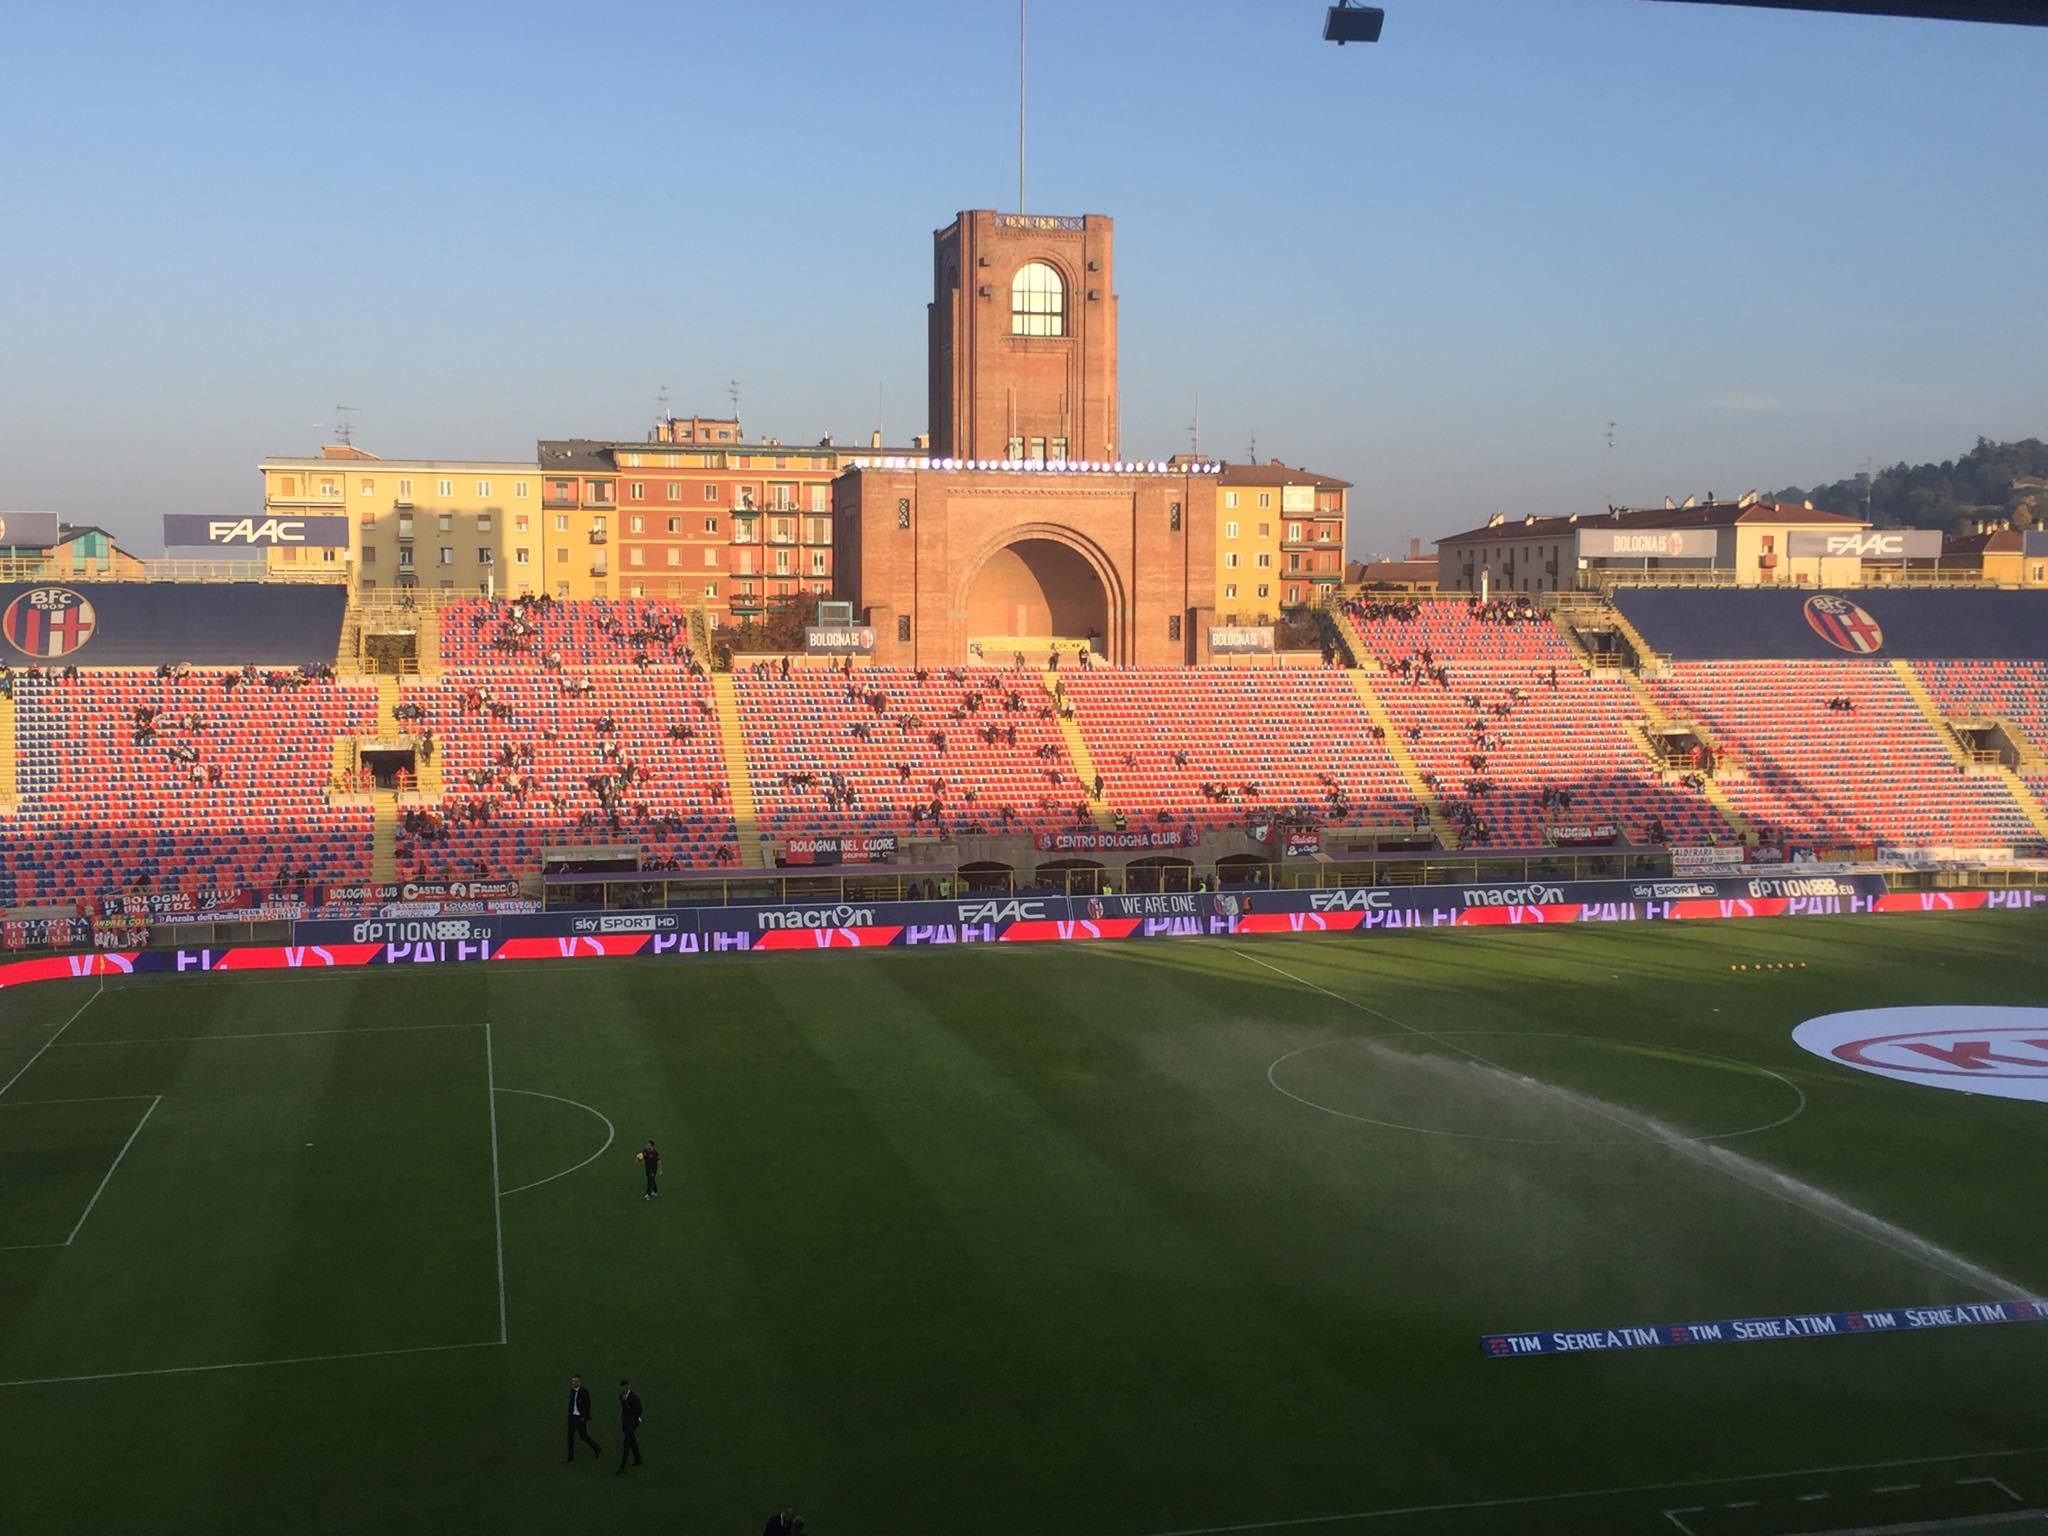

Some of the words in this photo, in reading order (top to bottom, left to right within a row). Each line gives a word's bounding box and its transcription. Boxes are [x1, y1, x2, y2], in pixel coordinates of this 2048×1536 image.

[209, 519, 305, 543] FAAC
[1613, 535, 1658, 552] BOLOGNA
[1827, 534, 1903, 555] FAAC
[30, 590, 72, 604] BFC
[1812, 597, 1847, 609] BFC
[810, 632, 851, 647] BOLOGNA
[1212, 632, 1250, 646] BOLOGNA
[790, 840, 838, 852] BOLOGNA
[841, 840, 859, 851] NEL
[862, 838, 896, 850] CUORE
[1056, 835, 1097, 848] CENTRO
[1100, 833, 1149, 847] BOLOGNA
[1151, 831, 1182, 845] CLUBS
[268, 893, 299, 901] CLUB
[329, 888, 373, 900] BOLOGNA
[375, 886, 398, 898] CLUB
[403, 883, 447, 900] CASTEL
[1463, 884, 1564, 906] macron
[1633, 886, 1653, 899] sky
[1657, 883, 1697, 896] SPORT
[1701, 883, 1715, 894] HD
[122, 893, 191, 905] BOLOGNA
[1120, 897, 1143, 914] WE
[1145, 896, 1170, 914] ARE
[1170, 895, 1197, 912] ONE
[1310, 889, 1393, 911] FAAC
[124, 903, 150, 913] UNA
[155, 901, 197, 912] FEDE.
[958, 901, 1046, 923] FAAC
[7, 918, 89, 929] BOLOGNA
[575, 919, 599, 931] sky
[603, 917, 651, 929] SPORT
[657, 916, 676, 927] HD
[758, 905, 874, 929] macron
[1863, 1313, 1896, 1328] TIM
[1688, 1325, 1722, 1340] TIM
[1508, 1337, 1541, 1352] TIM
